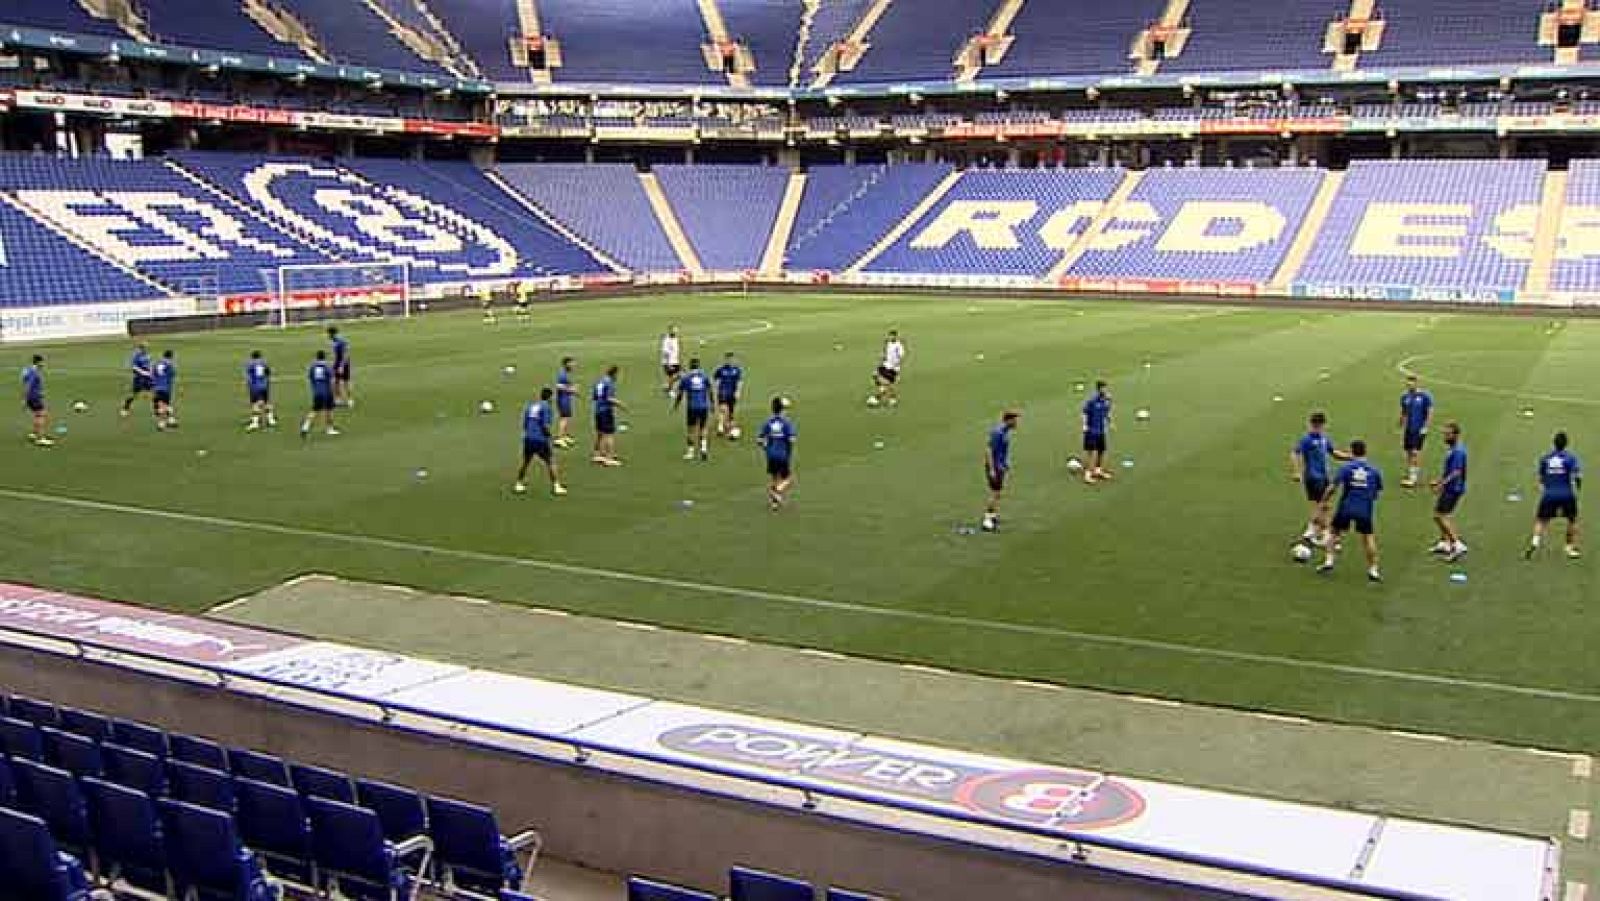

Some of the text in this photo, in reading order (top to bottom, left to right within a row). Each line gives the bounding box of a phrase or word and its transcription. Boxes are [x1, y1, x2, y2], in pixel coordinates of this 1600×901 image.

[0, 190, 296, 266] ER
[908, 199, 1288, 254] RCD
[690, 726, 960, 791] POWER
